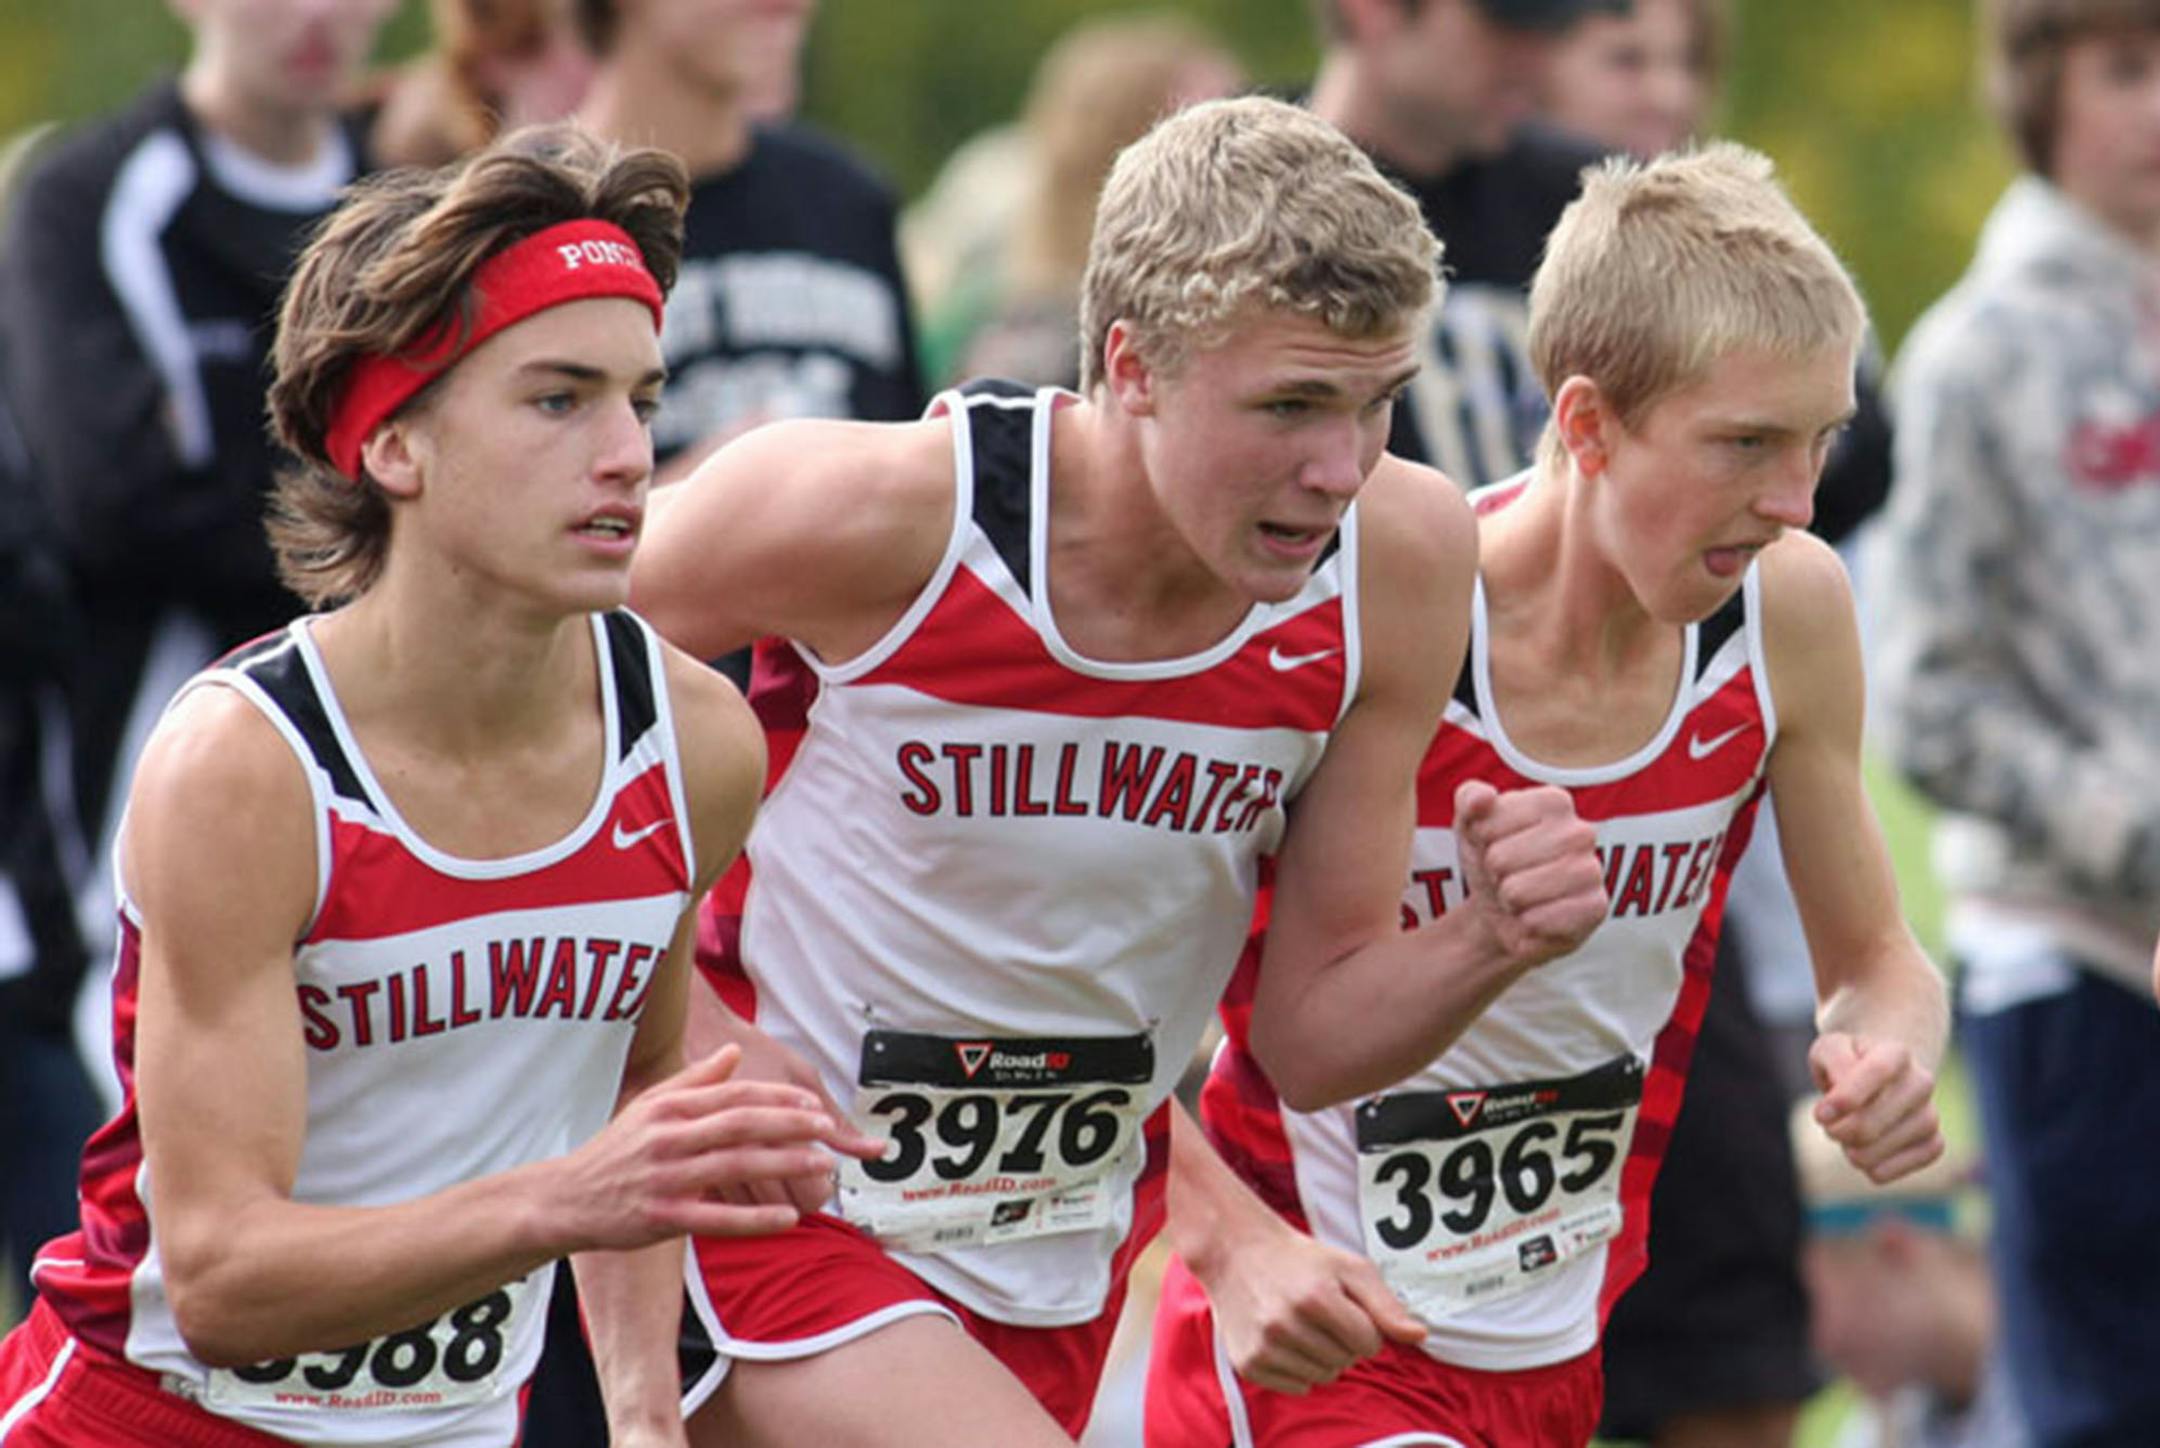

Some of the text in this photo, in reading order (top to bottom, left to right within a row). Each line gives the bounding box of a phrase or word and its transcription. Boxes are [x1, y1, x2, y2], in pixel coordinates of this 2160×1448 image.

[897, 740, 1283, 834] STILLWATER
[860, 1089, 1132, 1183] 3976
[1373, 1112, 1625, 1251] 3965
